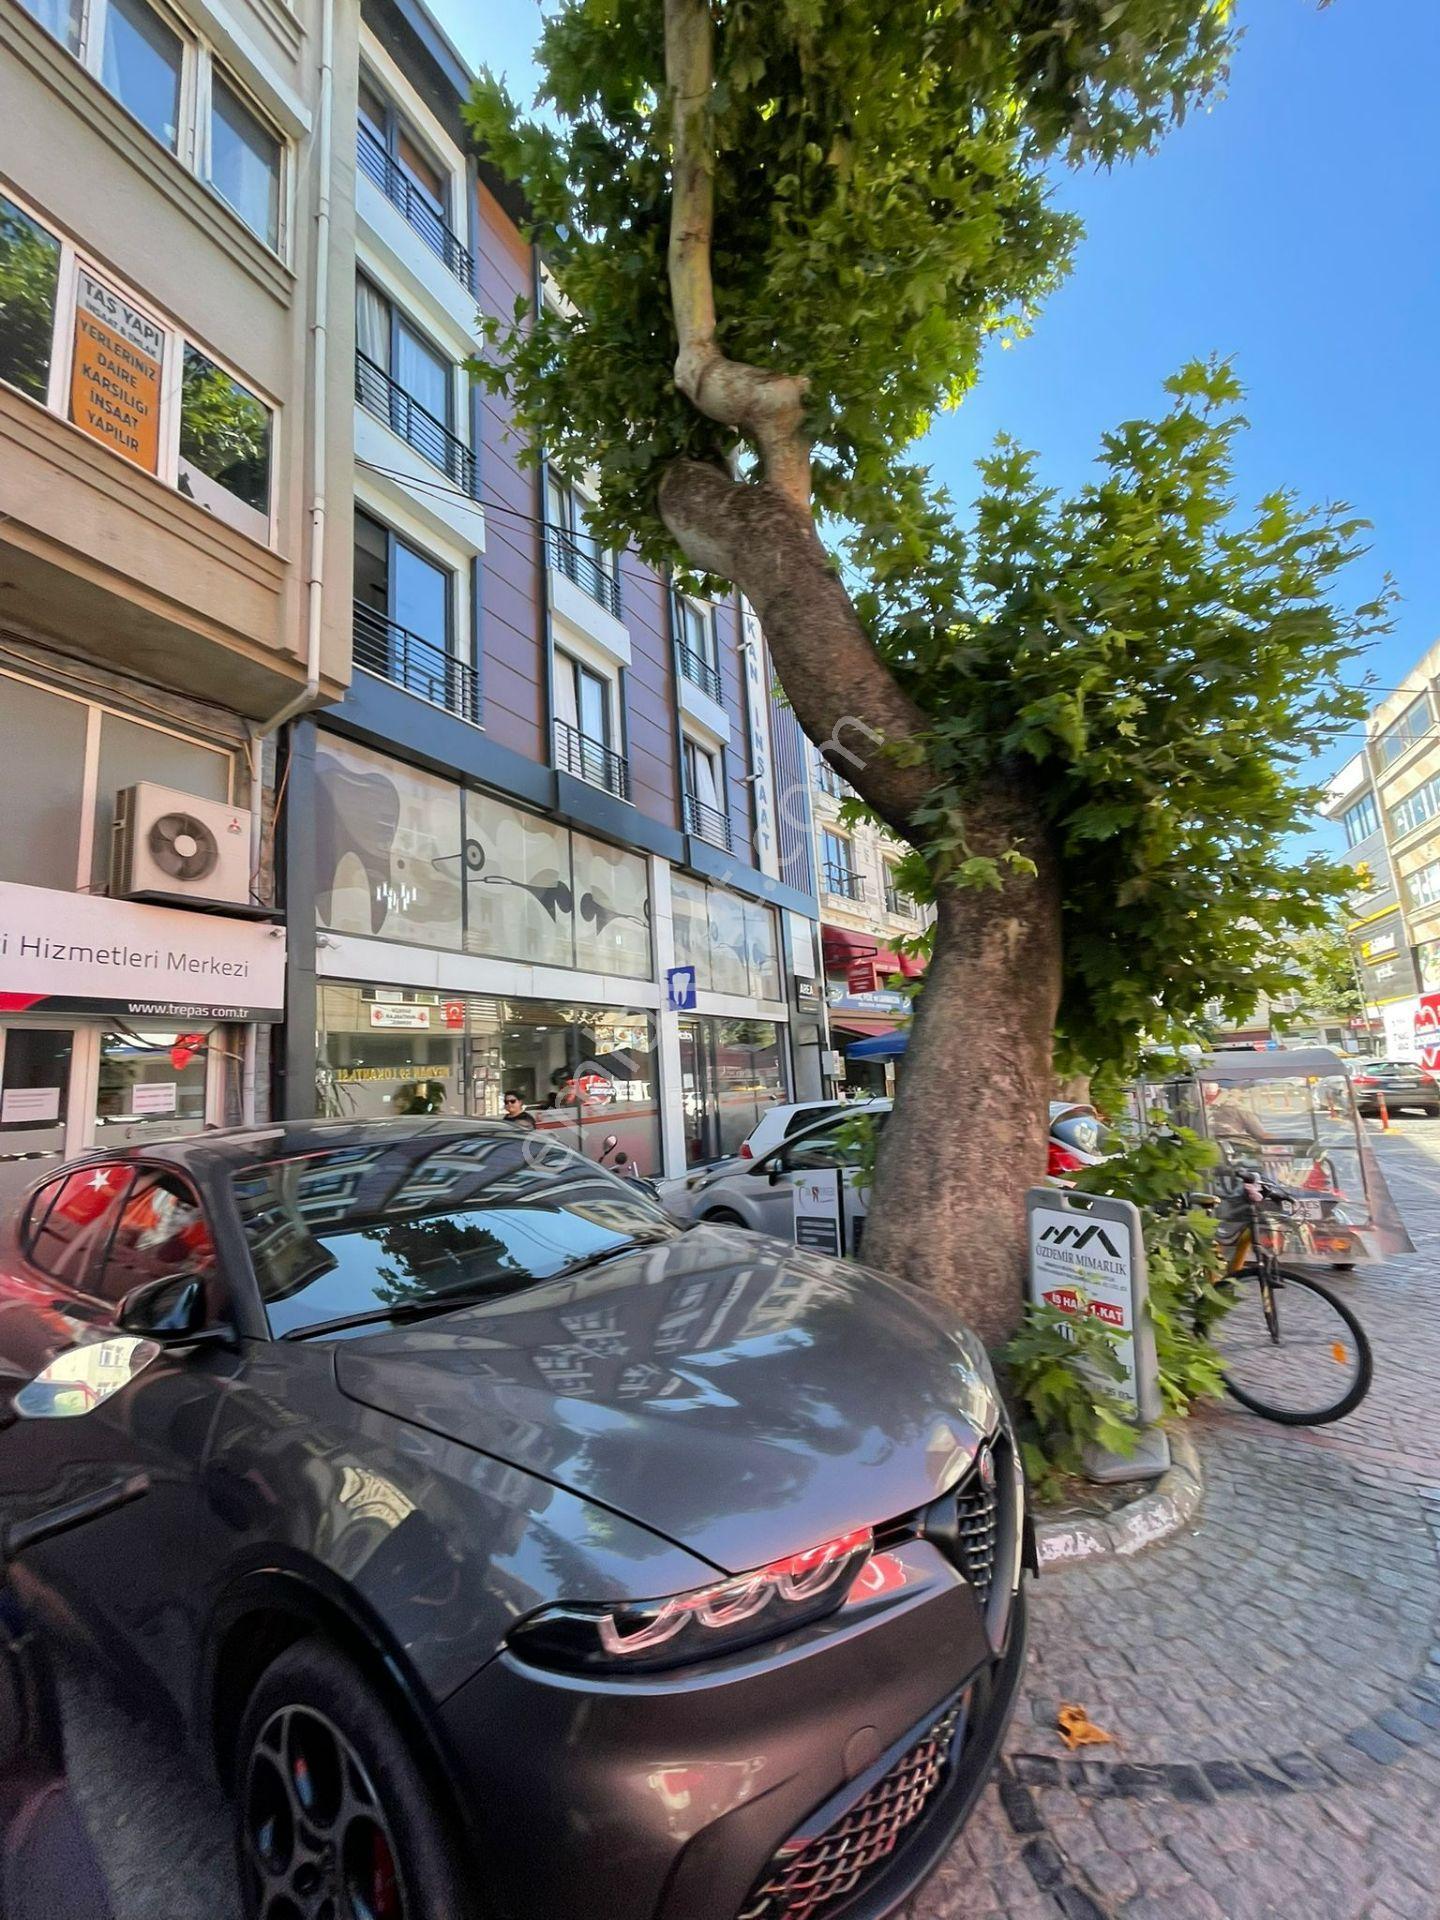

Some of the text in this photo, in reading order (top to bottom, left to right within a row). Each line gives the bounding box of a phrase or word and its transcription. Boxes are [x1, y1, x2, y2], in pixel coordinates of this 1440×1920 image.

[122, 307, 159, 347] YAPI
[86, 409, 139, 452] YAPILIR
[0, 932, 249, 978] i Hizmetleri Merkezi
